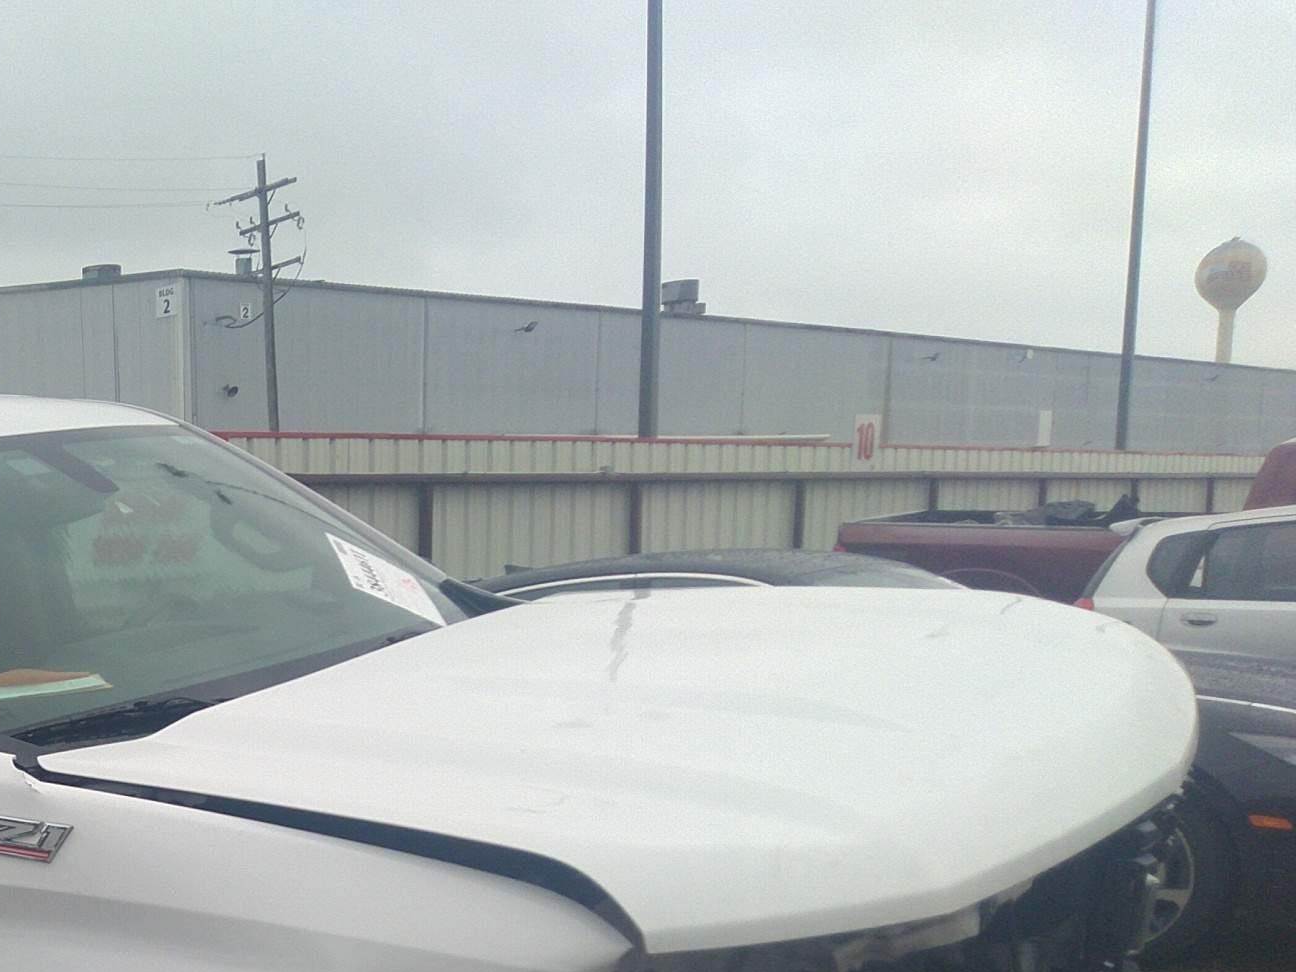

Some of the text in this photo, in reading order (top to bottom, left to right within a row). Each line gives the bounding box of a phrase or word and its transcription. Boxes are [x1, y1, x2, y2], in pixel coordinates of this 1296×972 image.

[163, 299, 170, 314] 2
[242, 306, 249, 319] 2
[856, 422, 875, 461] 10
